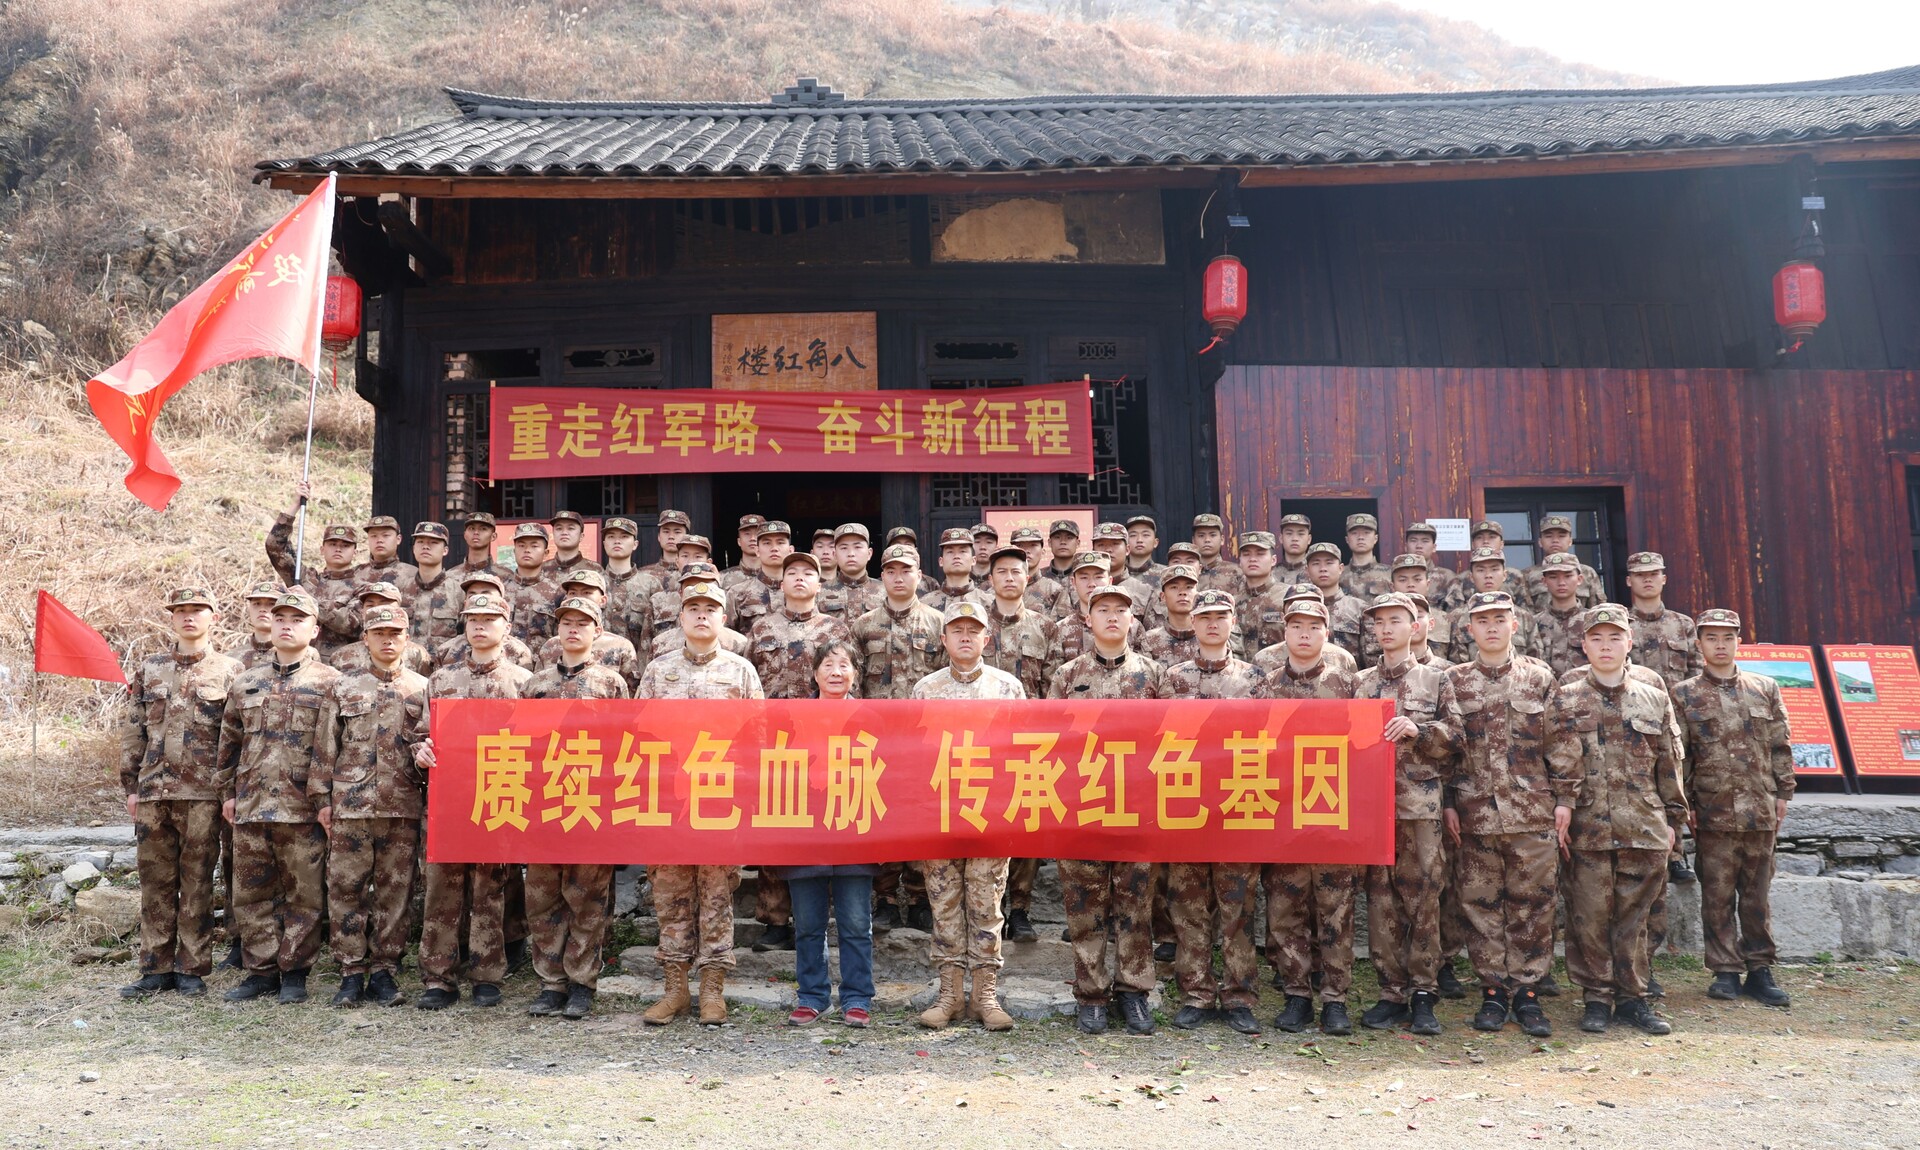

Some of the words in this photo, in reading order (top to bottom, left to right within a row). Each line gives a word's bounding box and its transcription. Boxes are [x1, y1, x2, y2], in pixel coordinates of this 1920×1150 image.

[737, 338, 867, 379] 八角红楼
[470, 728, 888, 835] 赓续红色血脉
[929, 729, 1349, 833] 传承红色基因
